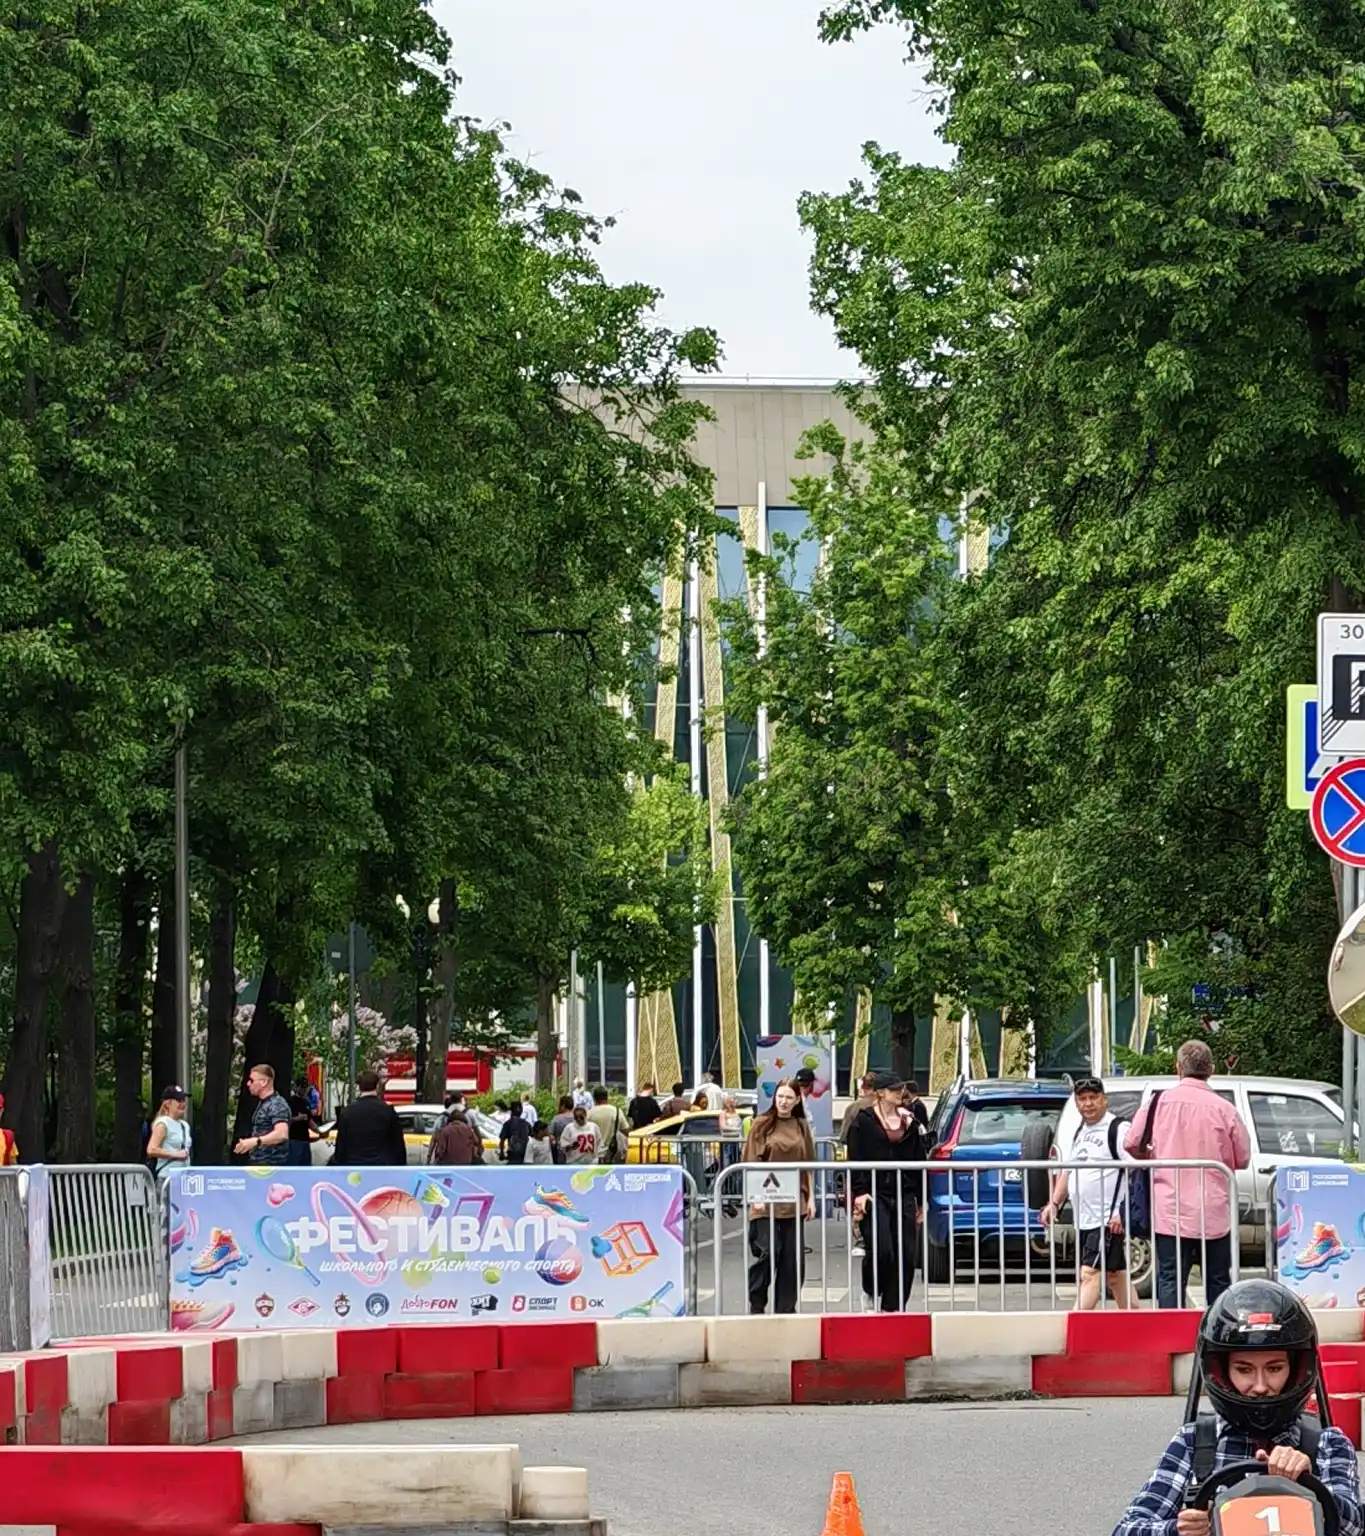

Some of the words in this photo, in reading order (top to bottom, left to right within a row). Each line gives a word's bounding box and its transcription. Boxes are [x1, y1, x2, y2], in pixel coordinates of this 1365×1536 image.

[284, 1215, 577, 1254] ФЕСТИВАЛЬ
[319, 1259, 399, 1273] ШКОЛЬНОГО
[401, 1258, 413, 1273] И
[414, 1256, 521, 1273] СТУДЕНЧЕСКОГО
[523, 1259, 577, 1274] СПОРТА
[528, 1297, 559, 1305] СПОРТ
[1254, 1505, 1281, 1533] 1
